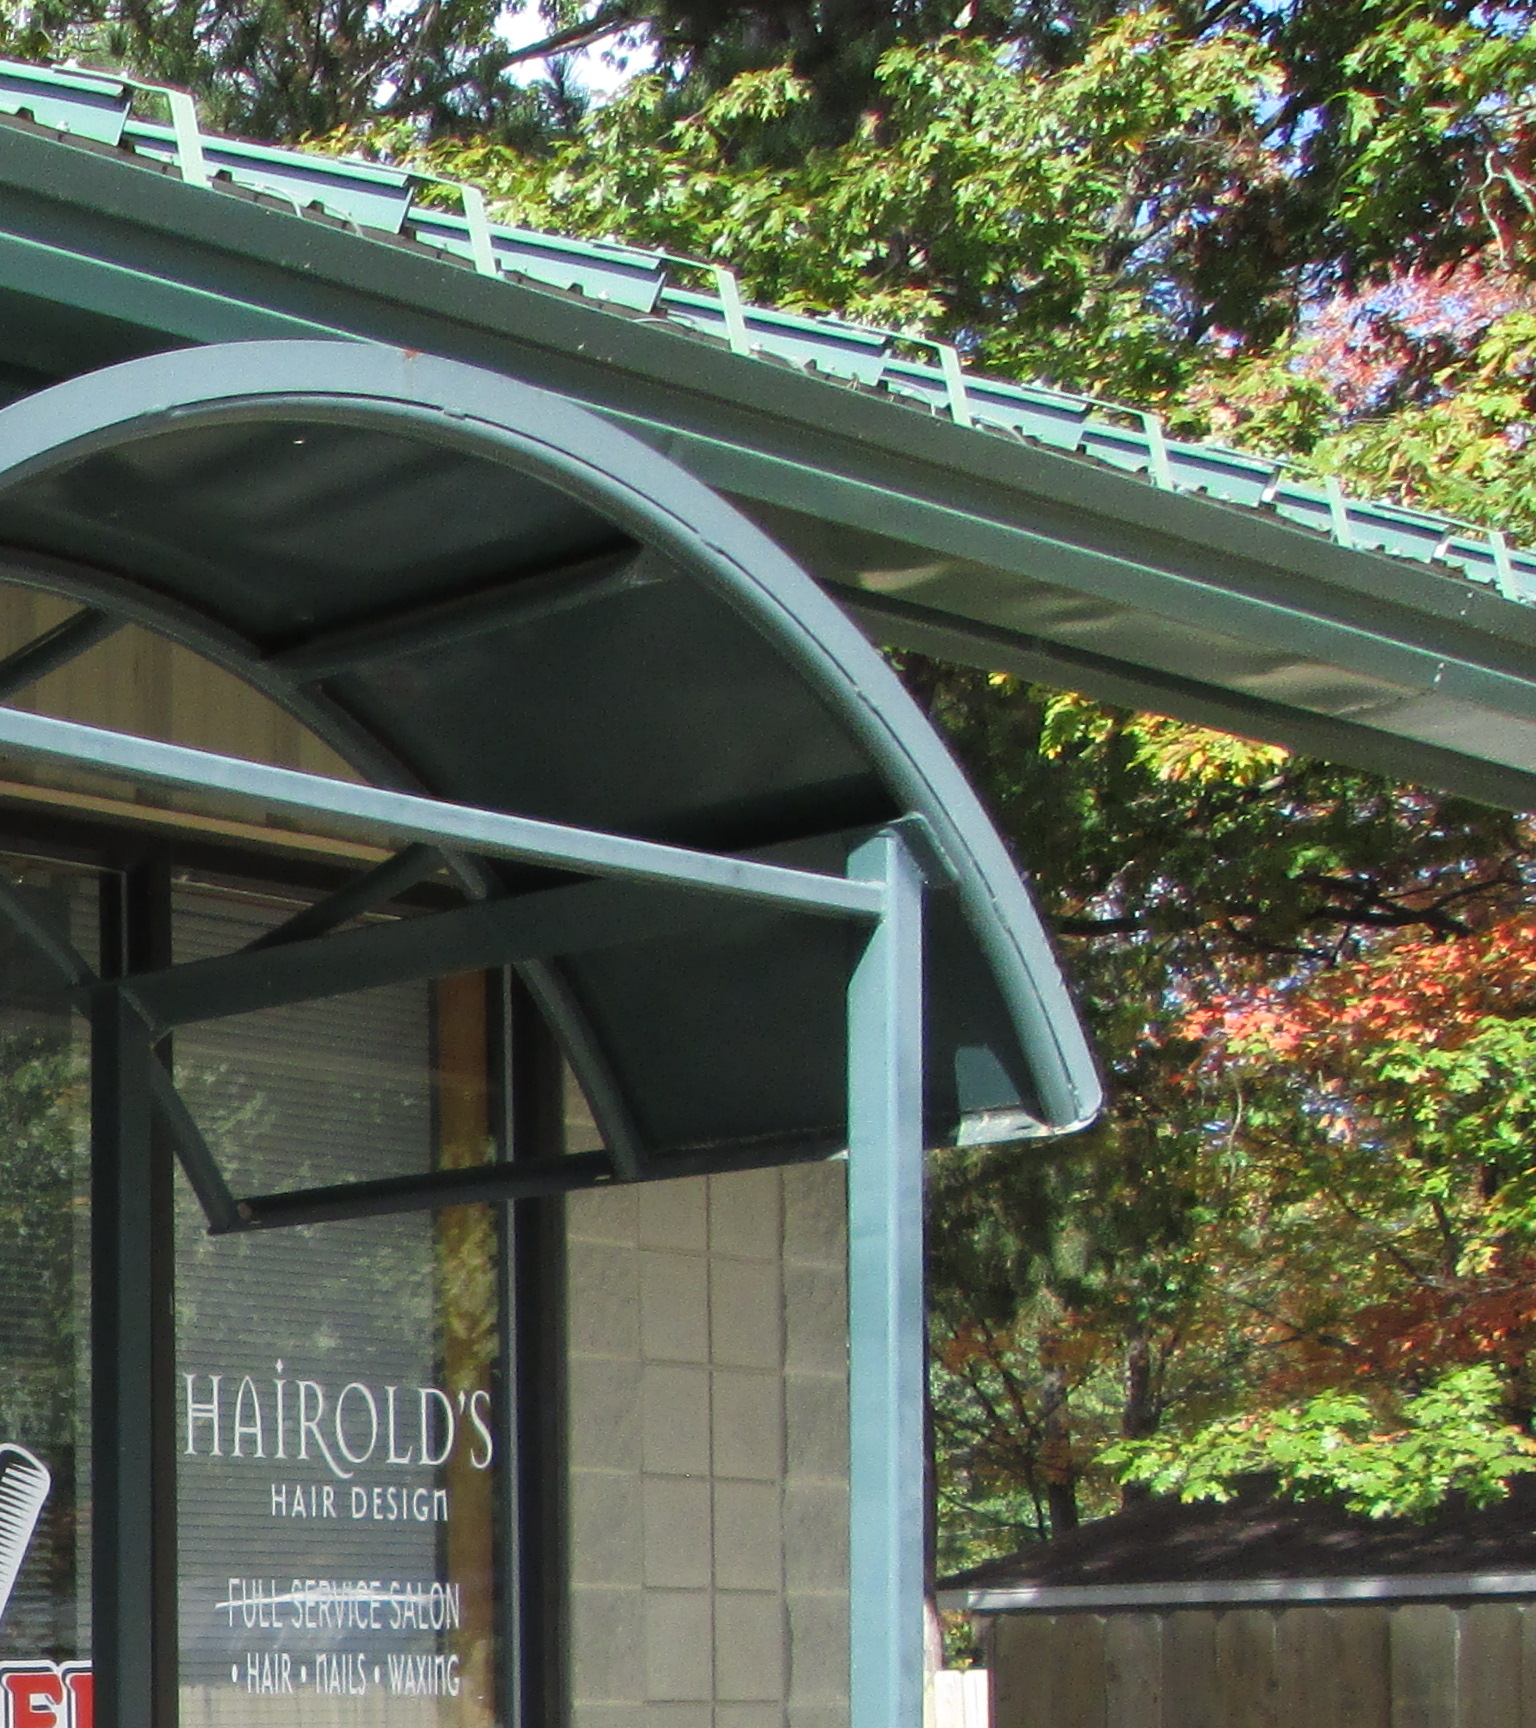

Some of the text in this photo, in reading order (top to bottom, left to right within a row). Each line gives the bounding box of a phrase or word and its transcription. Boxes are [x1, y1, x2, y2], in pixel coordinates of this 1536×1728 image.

[271, 1483, 337, 1519] HAIR
[229, 1578, 460, 1631] FULL SERVICE SALON
[247, 1652, 293, 1694] HAIR
